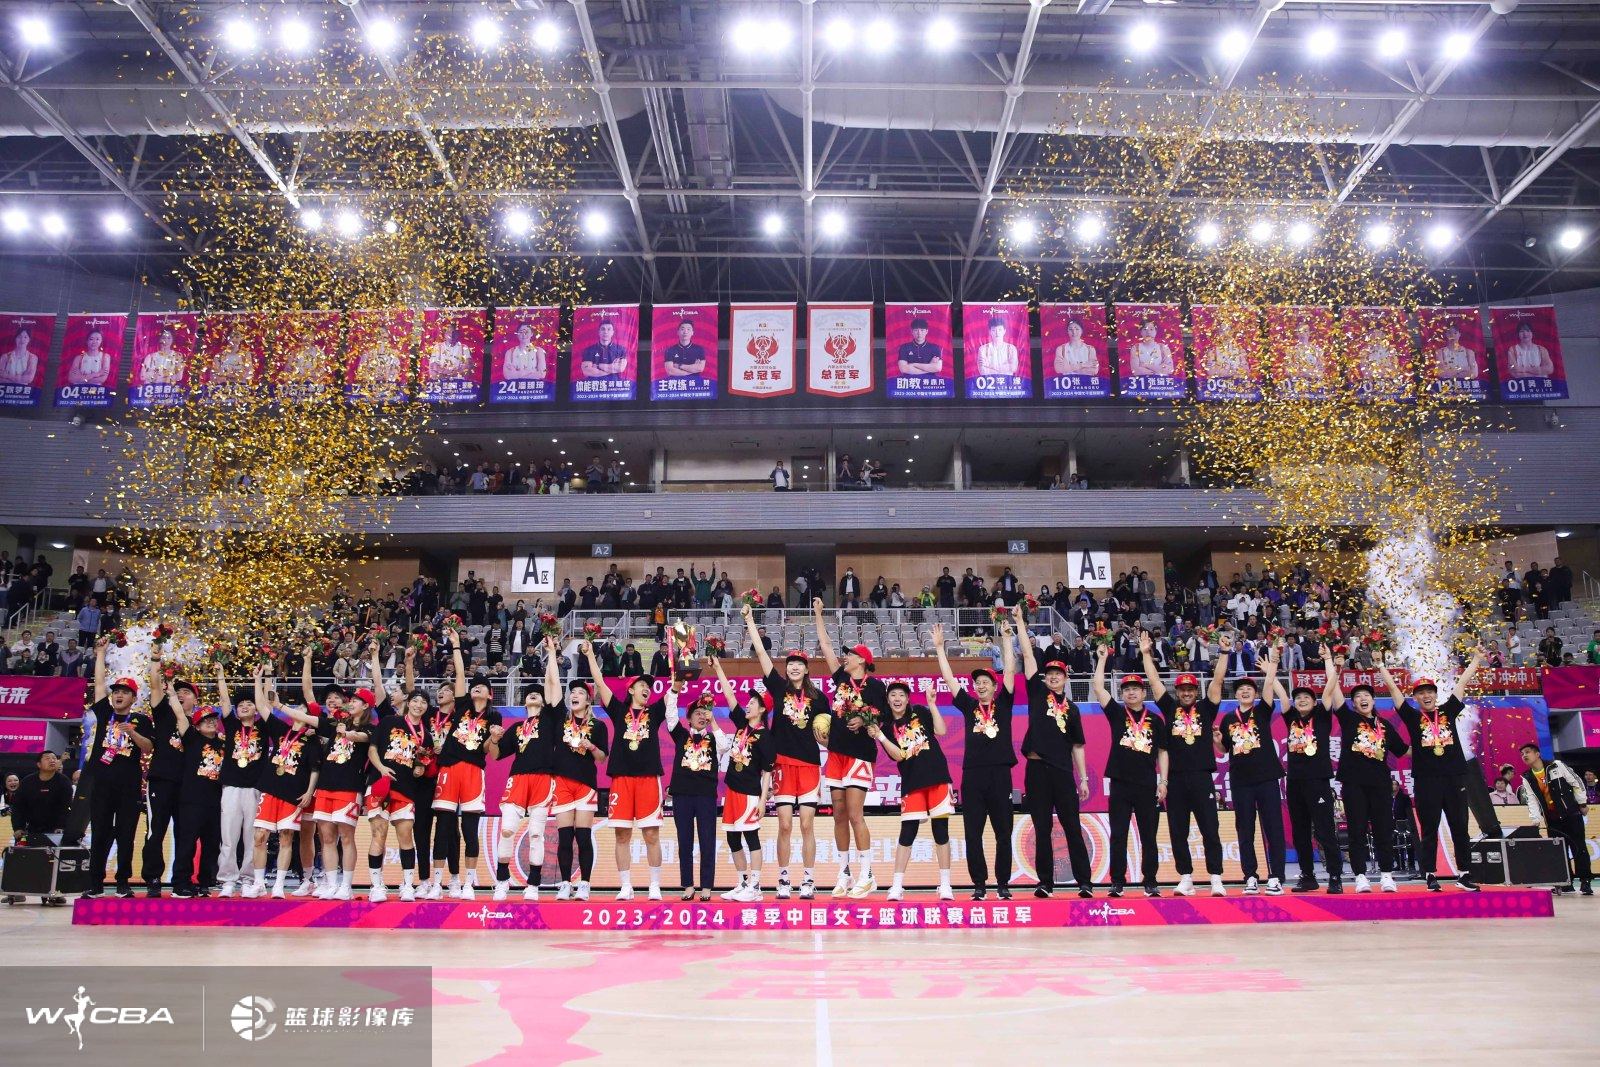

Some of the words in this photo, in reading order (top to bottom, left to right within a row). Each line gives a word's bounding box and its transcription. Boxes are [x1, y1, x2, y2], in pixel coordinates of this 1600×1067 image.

[744, 371, 781, 380] 总冠军
[822, 370, 859, 379] 总冠军
[499, 382, 517, 394] 24
[576, 381, 606, 392] 体能教练
[659, 381, 687, 391] 主教练
[897, 377, 921, 390] 助教
[976, 377, 996, 390] 02
[1053, 377, 1071, 390] 10
[1129, 378, 1145, 390] 31
[1508, 380, 1526, 392] 01
[62, 387, 80, 399] 04
[137, 386, 153, 398] 18
[1011, 543, 1025, 551] A3
[583, 910, 724, 925] 2023-2024
[742, 907, 1033, 925] 赛季中国女子篮球联赛总冠军
